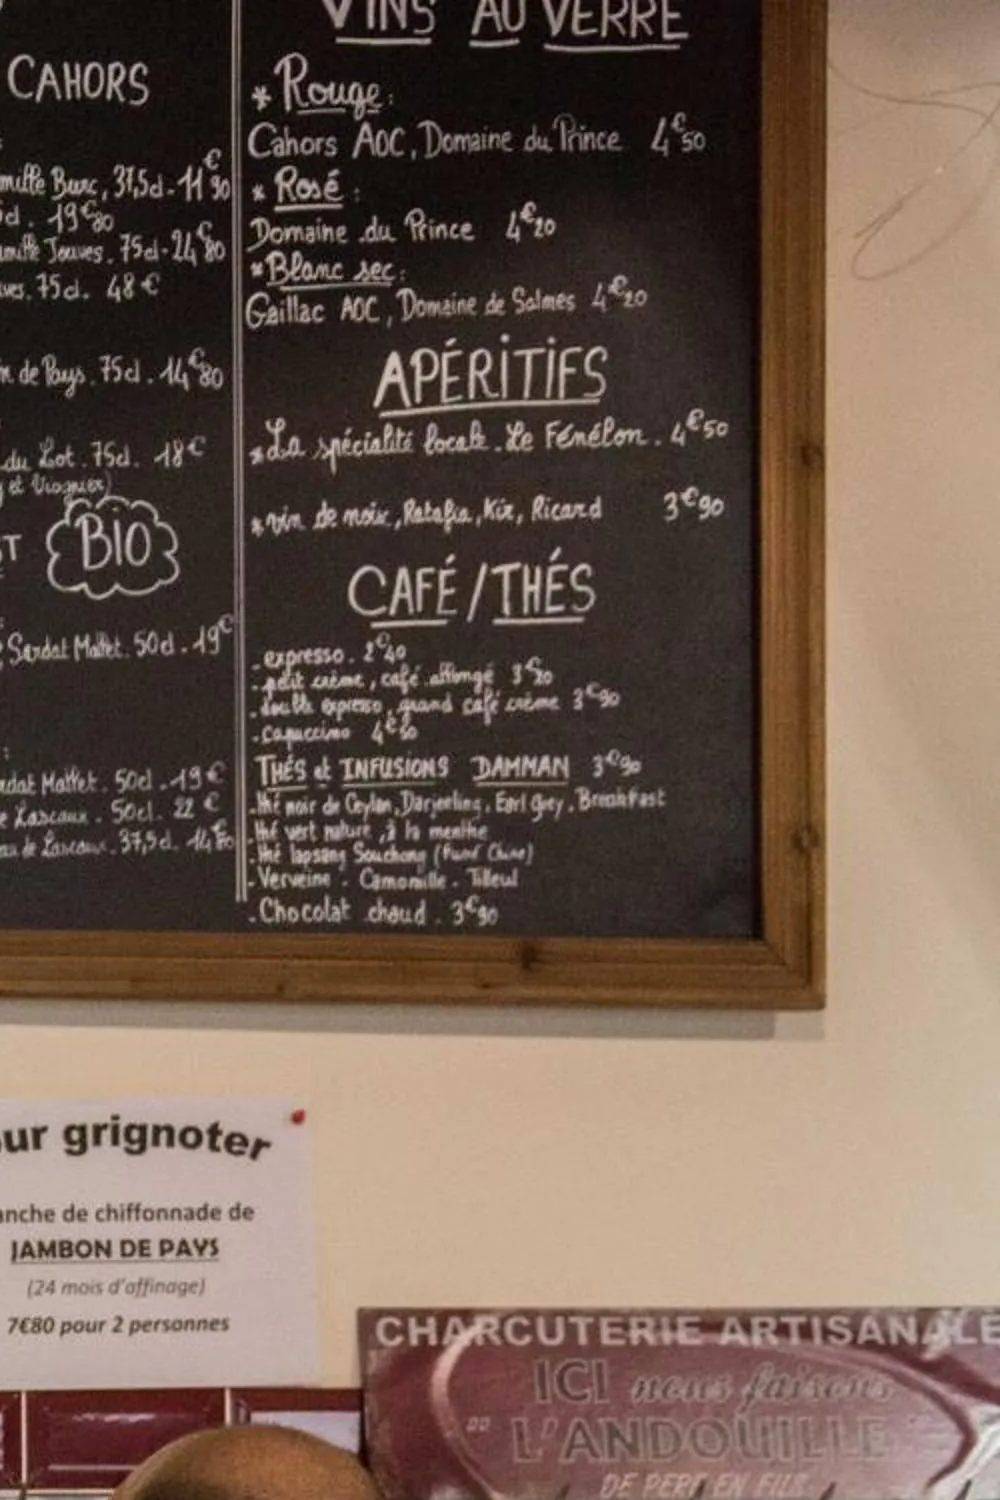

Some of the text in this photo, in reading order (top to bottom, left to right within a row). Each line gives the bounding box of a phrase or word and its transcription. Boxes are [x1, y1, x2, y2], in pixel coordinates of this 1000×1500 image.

[322, 0, 690, 40] VINS AU VERRE
[8, 54, 150, 105] CAHORS
[273, 52, 383, 121] Rouge
[248, 121, 339, 159] Cahors
[417, 119, 513, 158] Domaine
[524, 123, 552, 152] du
[553, 113, 623, 152] Prince
[274, 165, 344, 203] Rosé
[247, 217, 349, 251] Domaine
[358, 215, 397, 242] du
[404, 207, 476, 242] Prince
[265, 251, 396, 287] Blanc sec
[245, 292, 326, 329] Gaillac
[396, 288, 477, 323] Domaine
[485, 289, 505, 316] de
[259, 893, 427, 926] Chocolat chaud
[63, 1114, 271, 1163] grignoter
[63, 1203, 88, 1222] de
[95, 1201, 222, 1223] chiffonnade
[228, 1201, 255, 1221] de
[11, 1238, 220, 1261] JAMBON DE PAYS
[27, 1278, 56, 1298] (24
[61, 1278, 103, 1296] mois
[7, 1316, 230, 1338] 7€80 pour 2 personnes
[375, 1315, 1000, 1347] CHARCUTERIE ARTISANALE
[534, 1358, 612, 1404] ICI
[511, 1414, 889, 1462] L'ANDOUILLE
